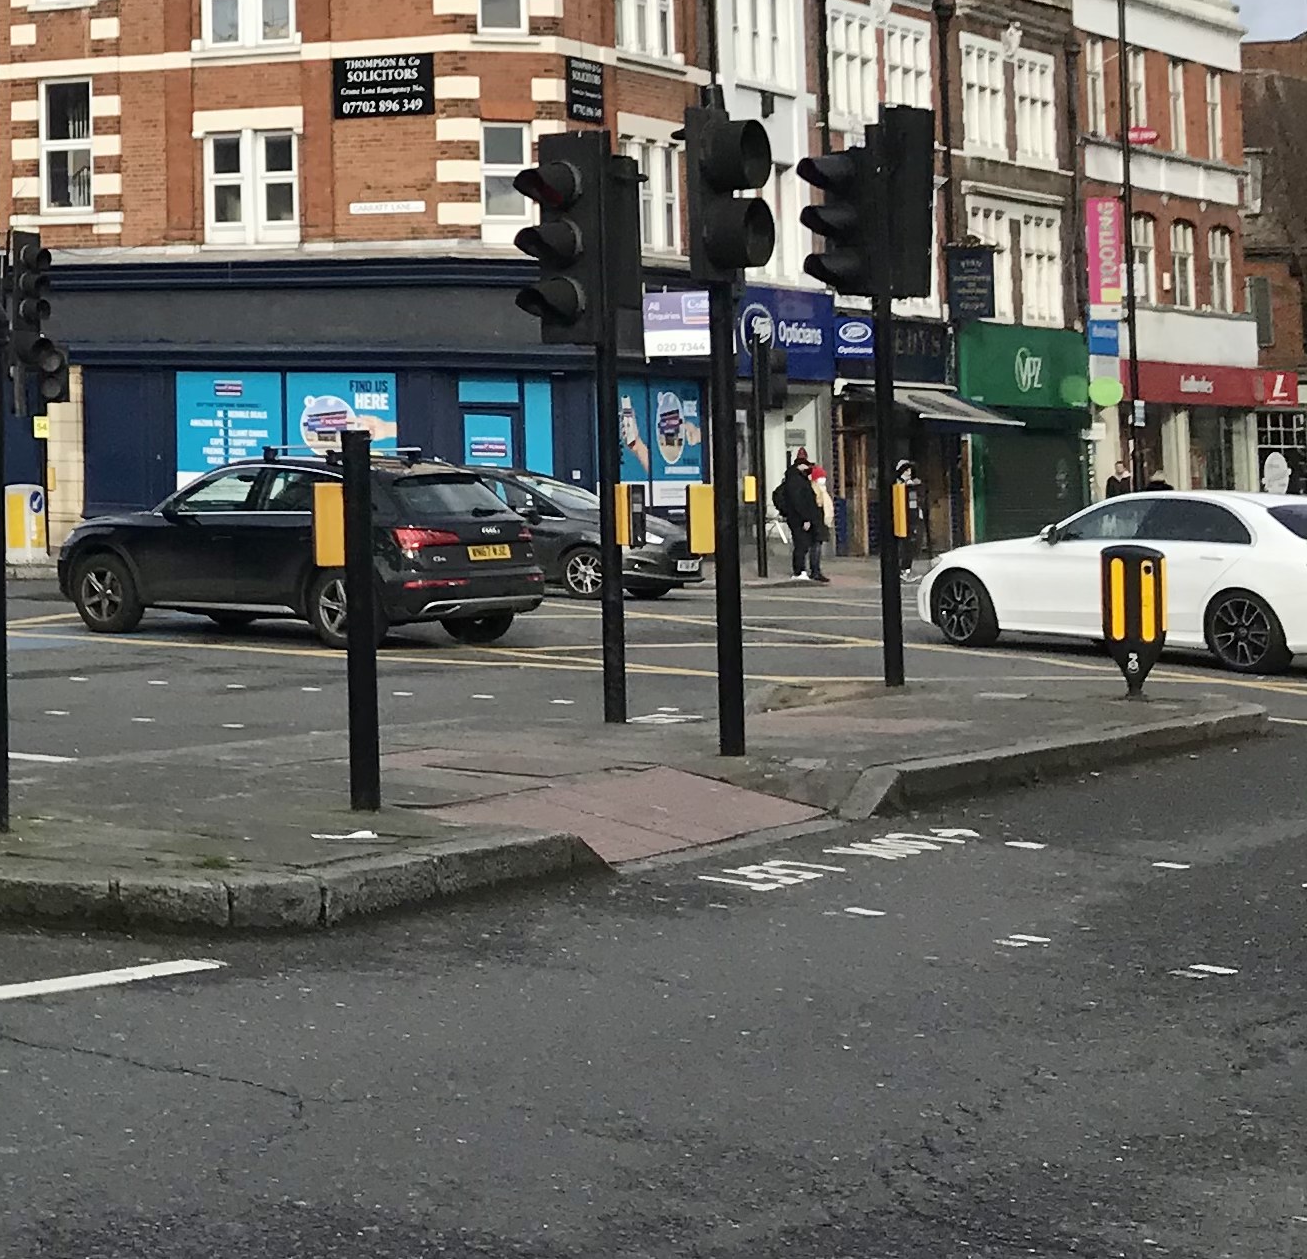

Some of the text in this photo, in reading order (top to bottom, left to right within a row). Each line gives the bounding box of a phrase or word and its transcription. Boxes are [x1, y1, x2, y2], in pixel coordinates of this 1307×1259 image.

[345, 56, 421, 70] THOMPSON & Co
[347, 68, 418, 83] SOLICITORS
[342, 97, 423, 114] 07702 896 349
[778, 320, 823, 346] Opticians
[657, 342, 706, 352] 020 7344
[349, 379, 388, 393] FIND US
[354, 393, 389, 410] HERE
[697, 860, 846, 891] LEFT
